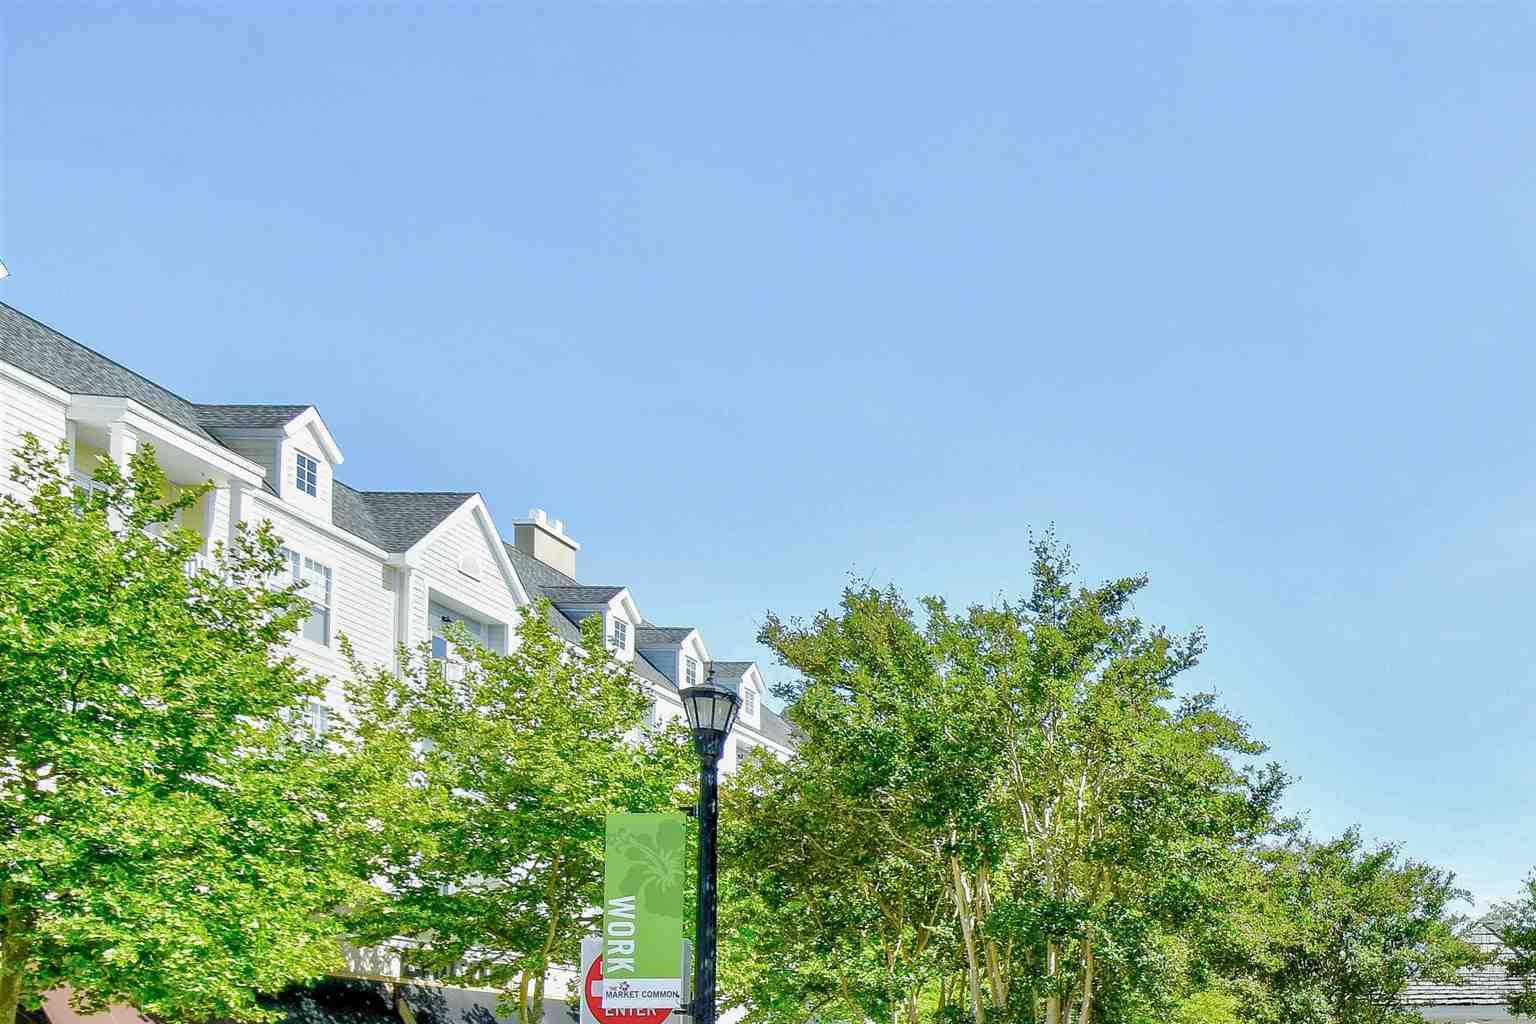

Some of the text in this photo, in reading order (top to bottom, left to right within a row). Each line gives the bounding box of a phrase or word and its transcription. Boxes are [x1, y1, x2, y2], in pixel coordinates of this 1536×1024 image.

[607, 895, 636, 973] WORK
[605, 990, 679, 999] MARKET COMMON
